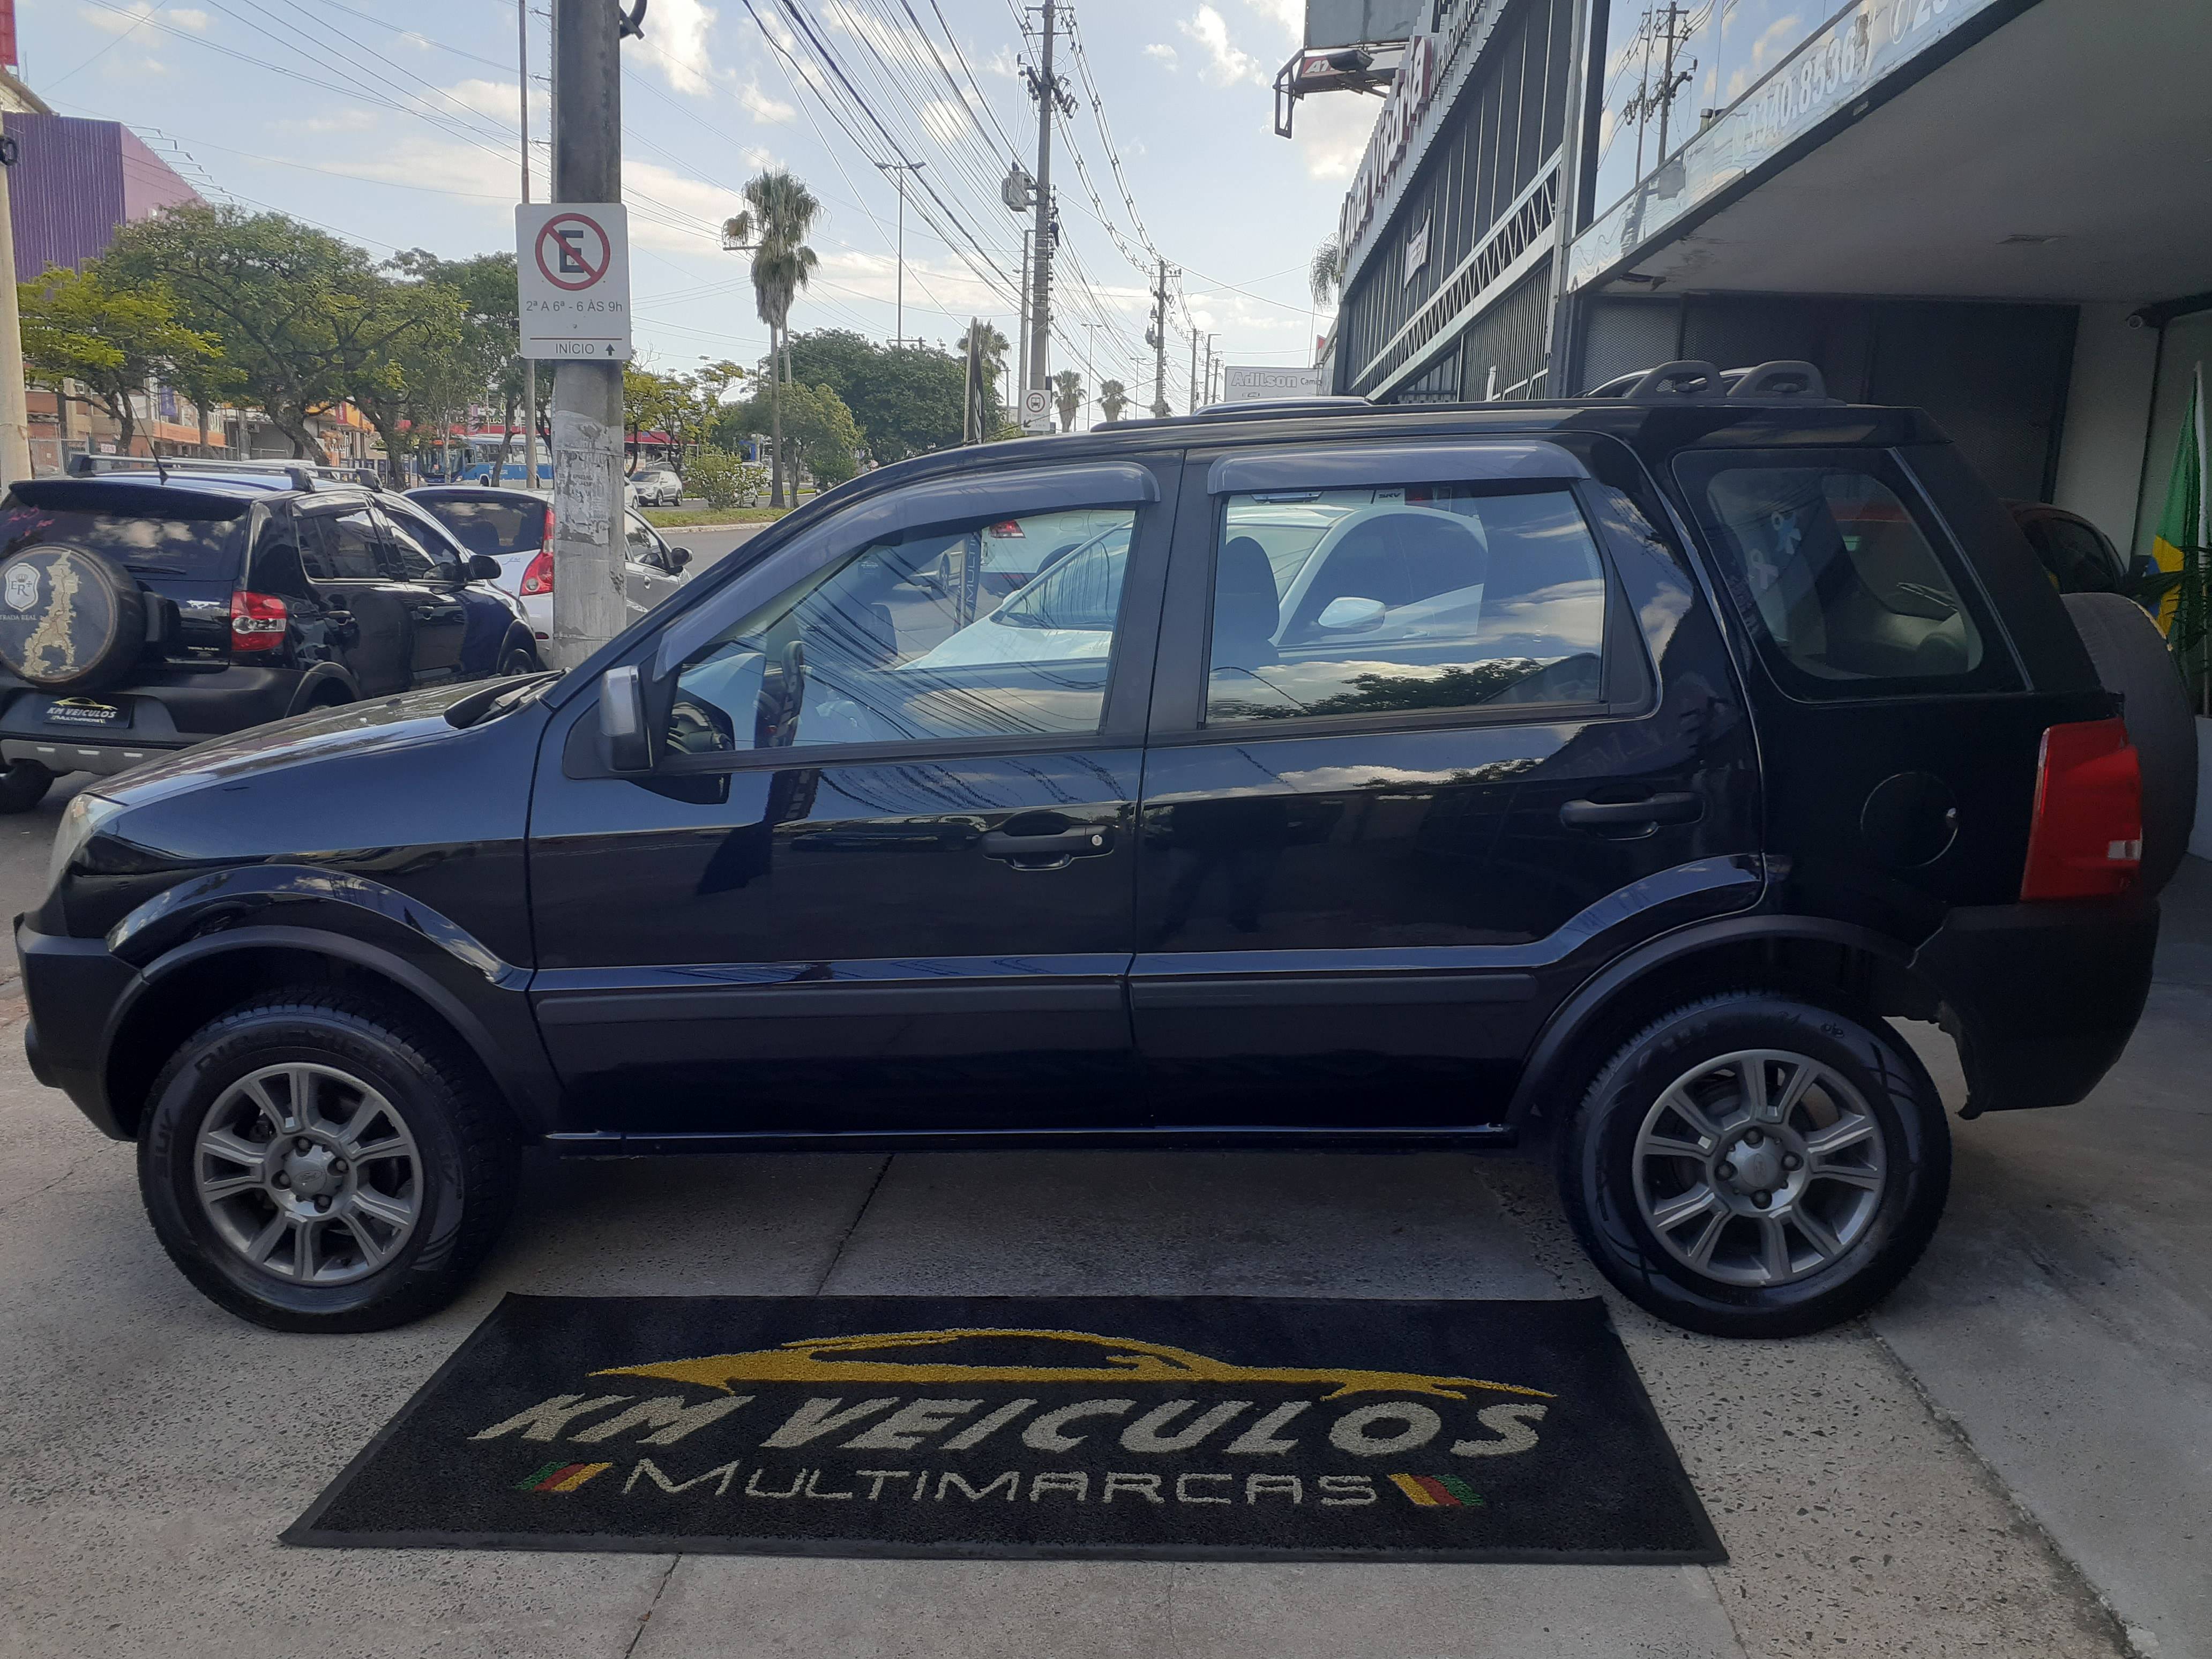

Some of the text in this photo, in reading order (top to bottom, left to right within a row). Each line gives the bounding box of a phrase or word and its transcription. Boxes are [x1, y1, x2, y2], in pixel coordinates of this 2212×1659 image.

[541, 302, 550, 312] A
[577, 301, 584, 312] 6
[608, 301, 622, 312] 9h
[555, 341, 594, 354] INÍCIO
[65, 708, 117, 719] VEICULOS
[466, 1393, 1549, 1458] KM VEICULOS
[622, 1457, 1378, 1505] MULTIMARCAS
